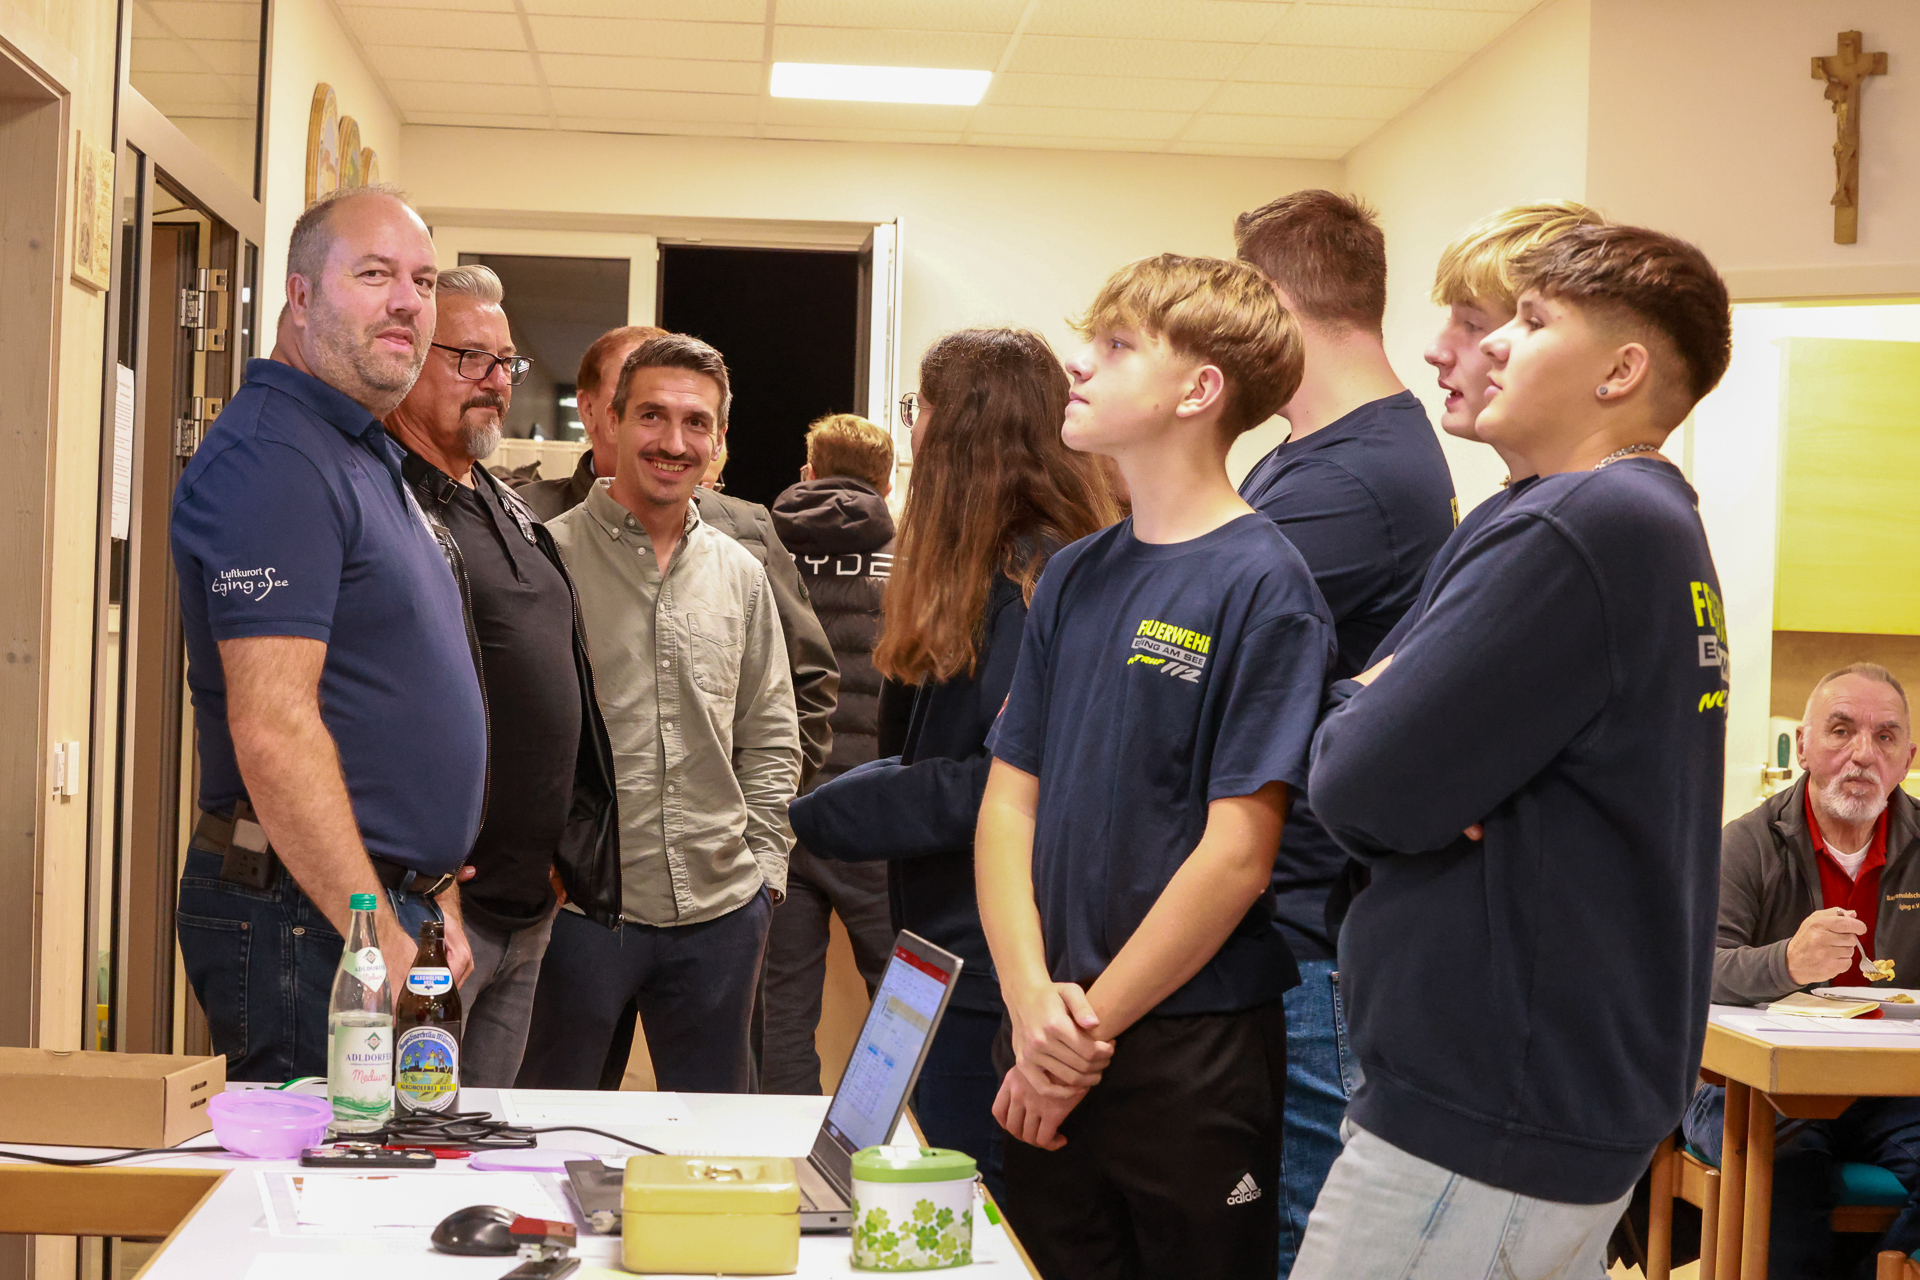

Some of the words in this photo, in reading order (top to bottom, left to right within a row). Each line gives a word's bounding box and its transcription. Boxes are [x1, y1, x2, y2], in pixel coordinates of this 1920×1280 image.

[220, 567, 263, 579] Luftkurort
[211, 578, 254, 597] Eging
[1162, 647, 1180, 657] AM
[1183, 652, 1204, 667] SEE
[1160, 661, 1202, 684] 112
[1226, 1188, 1262, 1206] adidas
